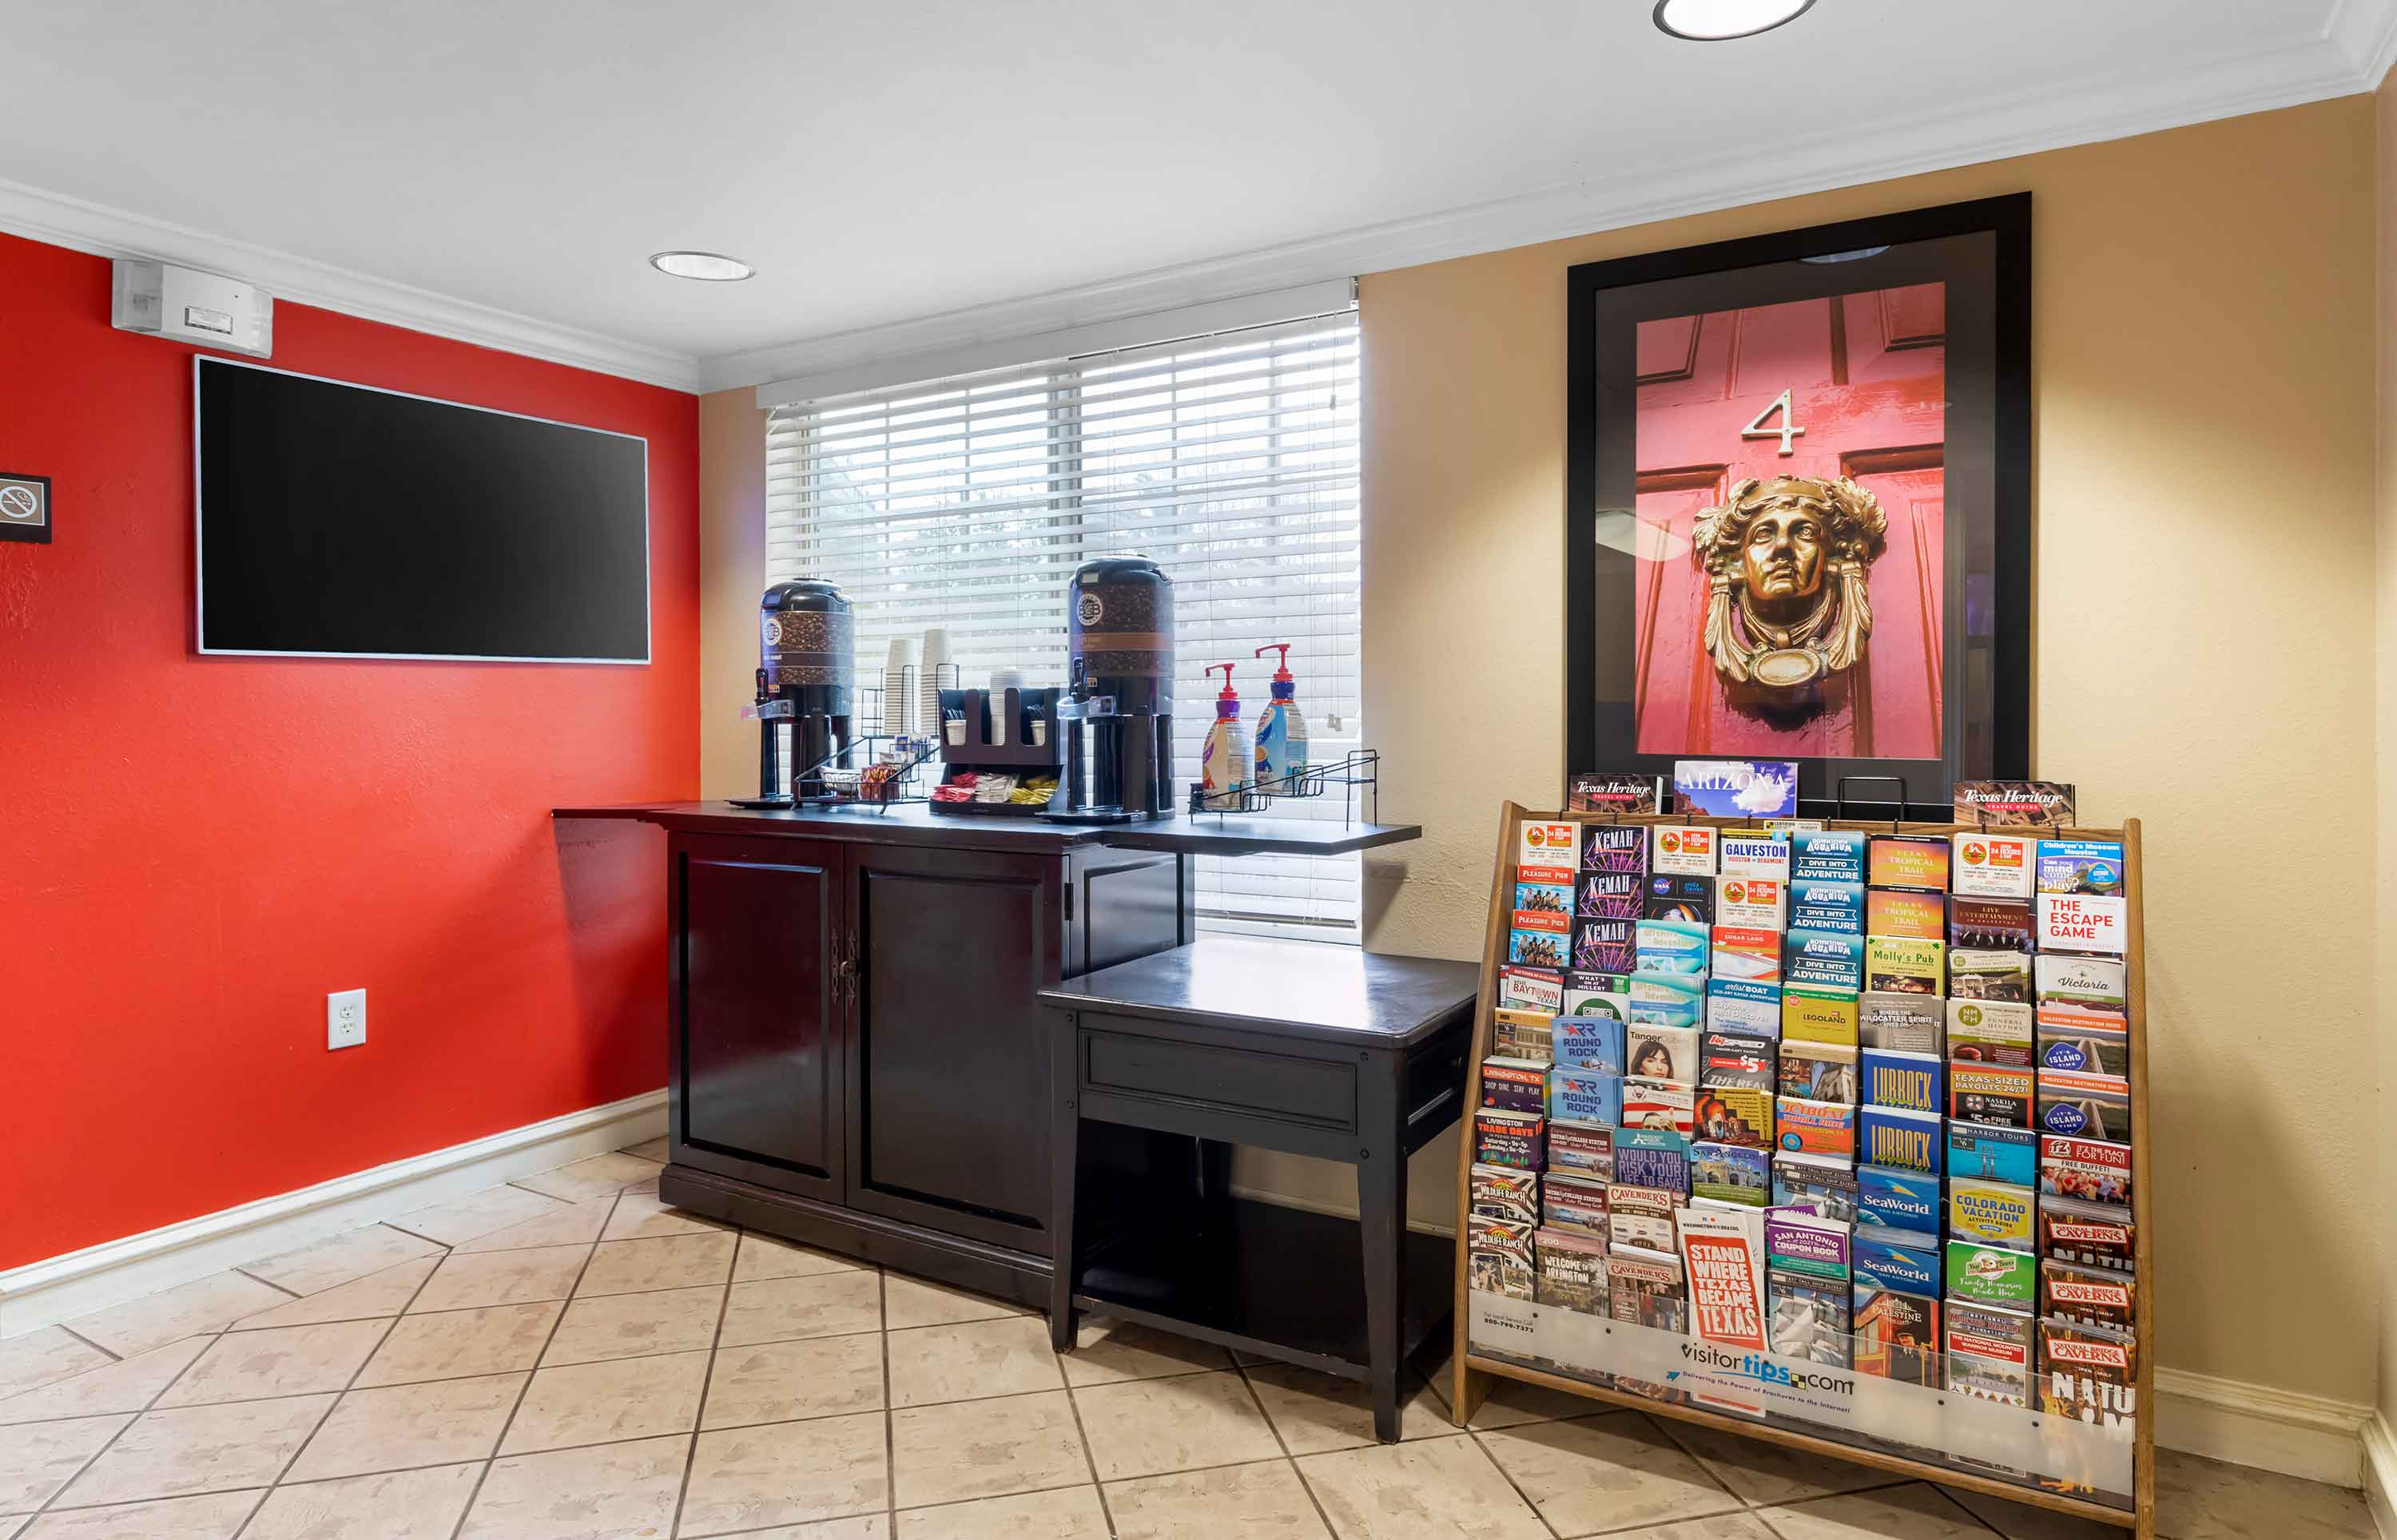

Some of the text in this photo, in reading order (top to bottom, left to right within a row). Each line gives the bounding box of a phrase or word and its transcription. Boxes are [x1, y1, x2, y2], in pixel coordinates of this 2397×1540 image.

[1741, 389, 1806, 457] 4
[1679, 772, 1787, 790] ARIZONA
[1577, 781, 1652, 797] Texas Heritage
[1963, 789, 2063, 808] Texas Heritage
[1596, 831, 1633, 848] KEMAH
[1726, 843, 1787, 857] GALVESTON
[1806, 842, 1852, 853] AQUARIUM
[1797, 870, 1858, 879] ADVENTURE
[2044, 863, 2073, 873] mind
[1590, 875, 1630, 895] KEMAH
[2045, 878, 2079, 892] play?
[1804, 890, 1850, 903] AQUARIUM
[2050, 899, 2081, 911] THE
[1518, 916, 1564, 927] PLEASURE PIER
[1959, 912, 2023, 921] ENTERTAINMENT
[2050, 912, 2113, 927] ESCAPE
[1795, 919, 1857, 931] ADVENTURE
[1585, 923, 1625, 943] KEMAH
[2050, 926, 2096, 939] GAME
[1803, 941, 1851, 955] AQUARIUM
[1874, 951, 1934, 963] Molly's Pub
[1793, 970, 1857, 984] ADVENTURE
[2058, 978, 2109, 990] Victoria
[1745, 986, 1768, 994] BOAT
[1537, 997, 1558, 1006] TEXAS
[1803, 1012, 1846, 1024] LEGOLAND
[1860, 1014, 1907, 1023] WILDCATTER
[1564, 1038, 1602, 1047] ROUND
[1569, 1048, 1598, 1057] ROCK
[2049, 1054, 2081, 1063] ISLAND
[1485, 1069, 1528, 1082] LIVINGSTON,
[1954, 1074, 2029, 1086] TEXAS-SIZED
[1485, 1080, 1497, 1090] SHOP
[1499, 1083, 1509, 1092] DINE
[1956, 1083, 2000, 1092] PAYOUTS
[1563, 1093, 1601, 1105] ROUND
[1986, 1097, 2017, 1106] NASKILA
[1567, 1104, 1598, 1114] ROCK
[1780, 1104, 1846, 1120] JETBOAT
[1486, 1118, 1523, 1127] LIVINGSTON
[2049, 1115, 2082, 1125] ISLAND
[1477, 1123, 1533, 1137] TRADE DAYS
[1967, 1128, 2029, 1142] HARBOR TOURS
[1485, 1137, 1509, 1146] Saturday
[1617, 1148, 1681, 1165] WOULD YOU
[1693, 1148, 1715, 1157] SAN
[2077, 1151, 2125, 1165] FOR FUN!
[2105, 1149, 2125, 1157] PLACE
[1618, 1161, 1682, 1177] RISK YOUR
[2081, 1163, 2109, 1173] BUFFET!
[1643, 1176, 1682, 1189] TO SAVE
[1480, 1184, 1526, 1204] WILDLIFE RANCH
[1611, 1189, 1668, 1206] CAVENDER'S
[1864, 1195, 1930, 1216] SeaWorld
[1956, 1195, 2025, 1215] COLORADO
[1962, 1206, 2020, 1223] VACATION
[1478, 1230, 1523, 1252] WILDLIFE RANCH
[1796, 1232, 1839, 1248] ANTONIO
[2057, 1228, 2123, 1241] CAVERNS
[1690, 1244, 1746, 1263] STAND
[1775, 1241, 1839, 1256] COUPON BOOK
[1545, 1256, 1581, 1269] WELCOME
[1545, 1266, 1589, 1284] ARLINGTON
[1611, 1264, 1670, 1282] CAVENDER'S
[1692, 1260, 1749, 1281] WHERE
[1863, 1259, 1930, 1282] SeaWorld
[1695, 1278, 1751, 1292] TEXAS
[1959, 1277, 1985, 1287] Family
[1698, 1289, 1754, 1308] BECAME
[2057, 1288, 2123, 1303] CAVERNS
[1872, 1304, 1922, 1323] PALESTINE
[1969, 1312, 2005, 1324] NATIONAL
[1702, 1307, 1758, 1336] TEXAS
[1961, 1341, 1986, 1351] WARRIOR
[1988, 1346, 2013, 1356] MUSEUM
[1964, 1337, 1991, 1347] NATIONAL
[1993, 1341, 2021, 1352] MOUNTED
[2054, 1342, 2118, 1356] NATURAL BRIDGE
[2054, 1345, 2123, 1363] CAVERNS
[1683, 1371, 1716, 1384] Delivering
[1718, 1377, 1728, 1386] the
[1731, 1380, 1751, 1391] Power
[1763, 1388, 1796, 1402] Brochures
